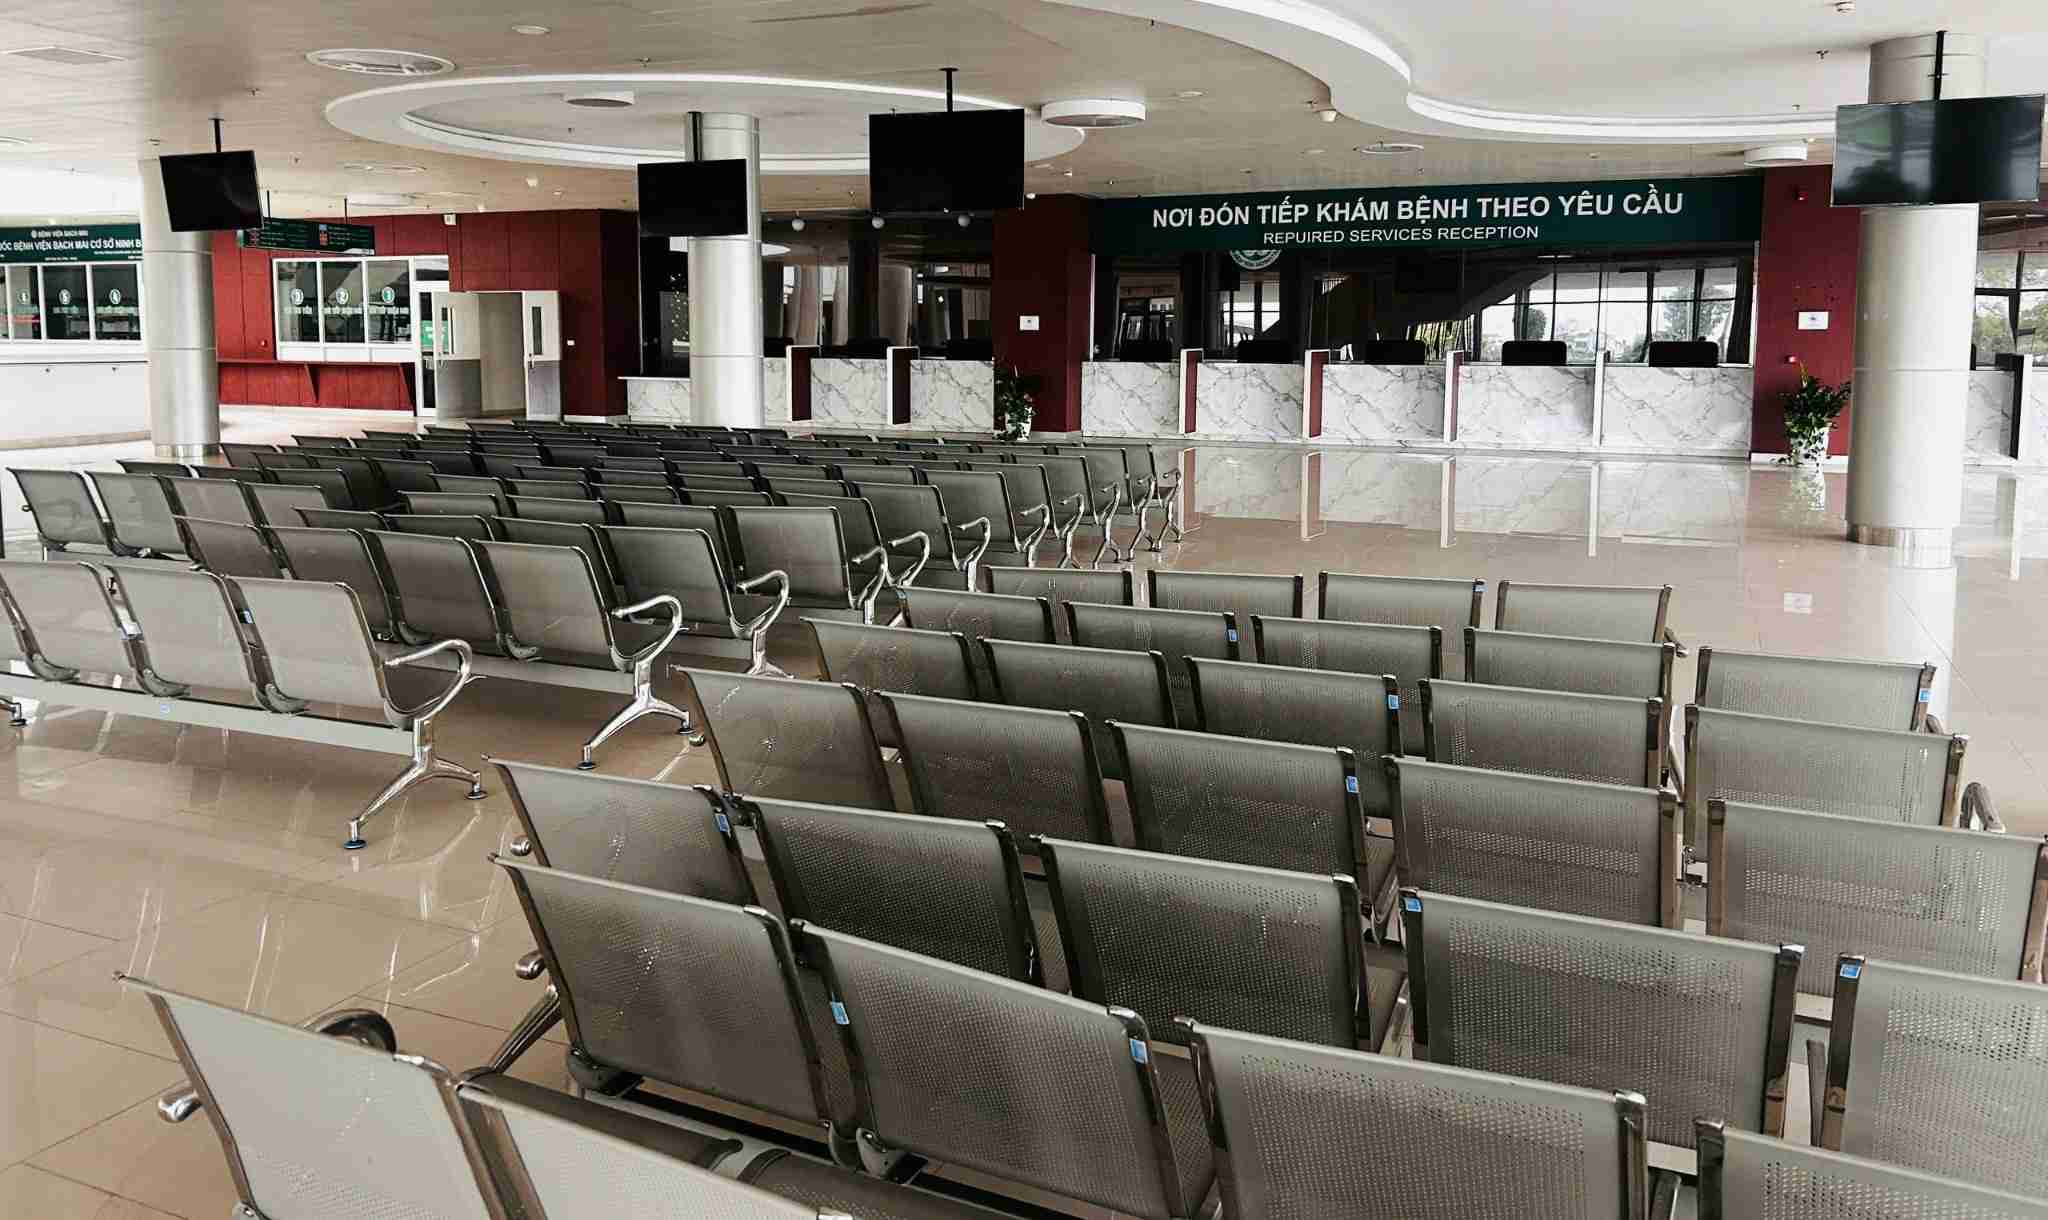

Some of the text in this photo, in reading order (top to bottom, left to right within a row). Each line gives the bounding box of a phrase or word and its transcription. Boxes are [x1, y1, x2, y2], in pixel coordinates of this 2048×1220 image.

[1152, 184, 1683, 228] NƠI ĐÓN TIẾP KHÁM BỆNH THEO YÊU CẦU
[1263, 226, 1539, 245] REPUIRED SERVICES RECEPTION
